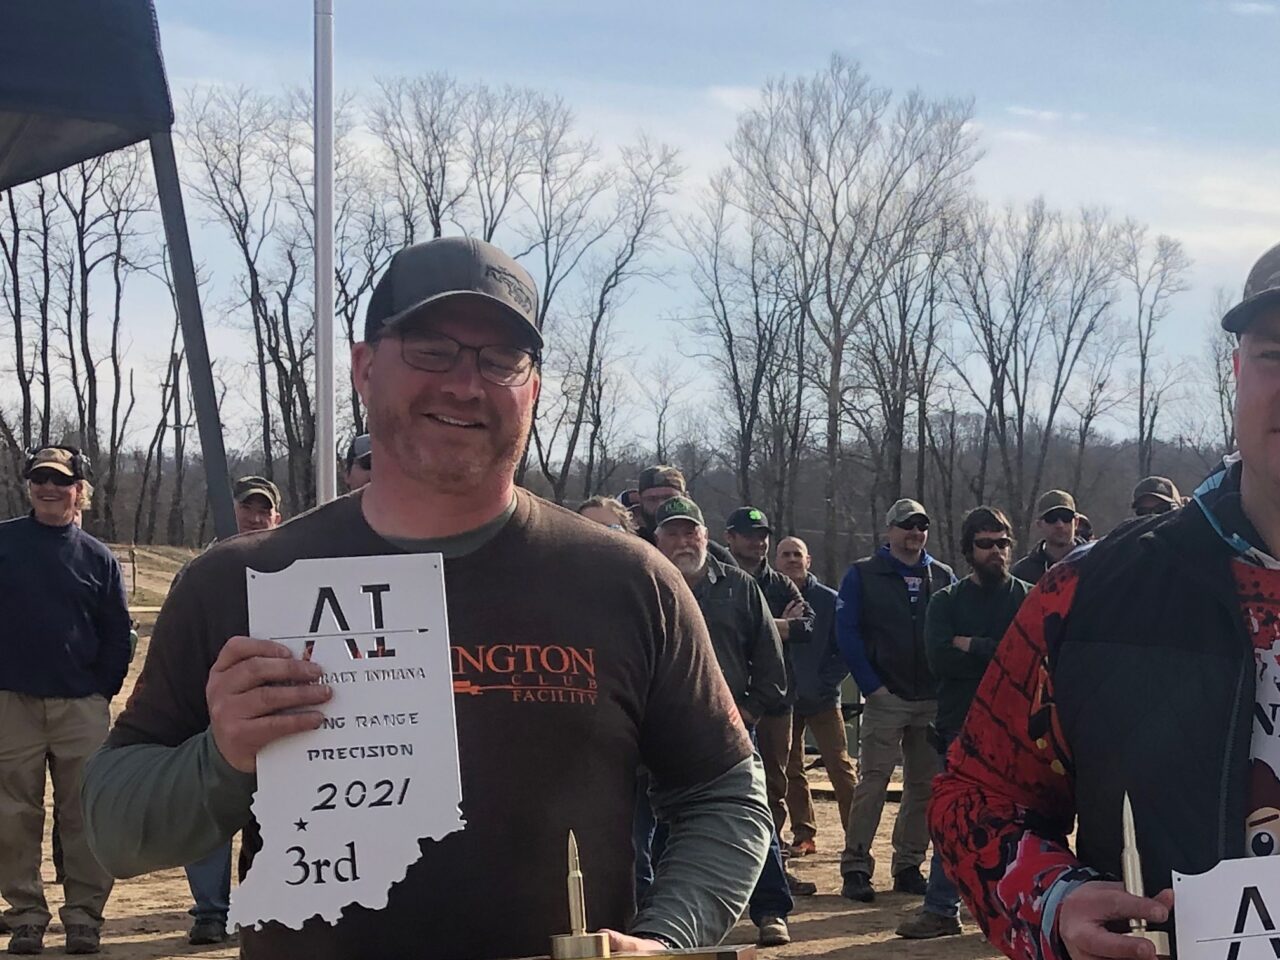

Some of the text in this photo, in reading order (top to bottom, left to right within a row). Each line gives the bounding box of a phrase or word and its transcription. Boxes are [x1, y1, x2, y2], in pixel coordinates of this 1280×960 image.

[450, 644, 597, 677] NGTON
[318, 667, 426, 685] RACY INDIANA
[512, 690, 598, 706] FACILITY
[320, 712, 419, 730] NG RANGE
[307, 743, 414, 761] PRECISION
[311, 777, 411, 811] 2021
[284, 840, 361, 886] 3rd
